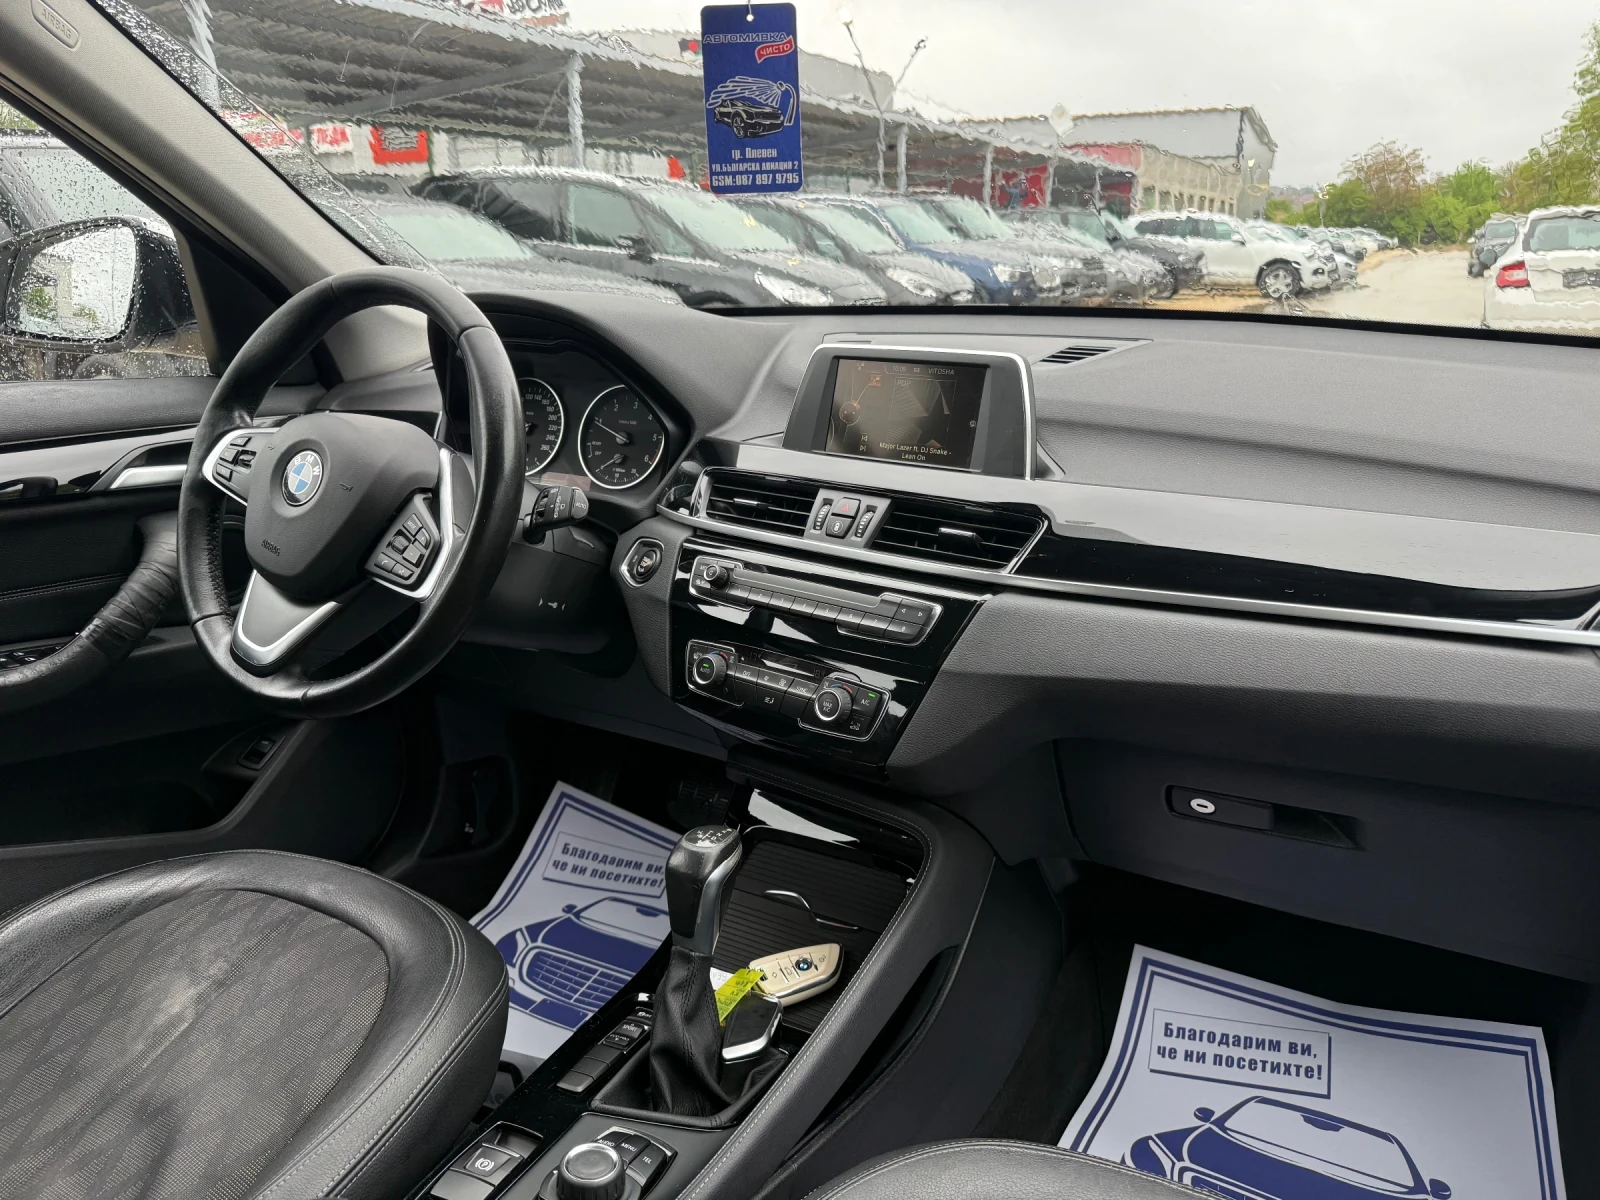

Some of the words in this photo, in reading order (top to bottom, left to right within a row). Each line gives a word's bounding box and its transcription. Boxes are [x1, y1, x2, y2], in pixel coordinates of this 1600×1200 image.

[42, 9, 71, 39] AIRBAG
[703, 32, 787, 43] АВТОМИВКА
[731, 149, 743, 161] гр.
[745, 147, 777, 159] Плевен
[761, 161, 793, 171] АВИАЦИЯ
[793, 160, 799, 170] 2
[712, 174, 753, 186] GSM:087
[755, 173, 773, 185] 897
[775, 172, 799, 184] 9795
[928, 368, 955, 376] VITOSHA
[897, 379, 912, 387] POP
[547, 423, 558, 431] 220
[879, 442, 896, 451] Major
[896, 443, 913, 452] Lazer
[920, 446, 929, 454] DJ
[929, 447, 948, 456] Snake
[901, 453, 916, 461] Lean
[294, 454, 320, 476] BMW
[860, 698, 871, 706] A/C
[561, 843, 644, 871] Благодарим
[645, 863, 665, 875] ви,
[552, 859, 568, 872] че
[570, 863, 588, 876] ни
[590, 868, 664, 888] посетихте!
[622, 1023, 639, 1032] SPORT
[1163, 1021, 1282, 1053] Благодарим
[1287, 1041, 1318, 1059] ви,
[1156, 1045, 1178, 1060] че
[1183, 1049, 1207, 1065] ни
[1212, 1053, 1323, 1081] посетихте!
[621, 1142, 637, 1152] MENU
[642, 1156, 652, 1165] TEL
